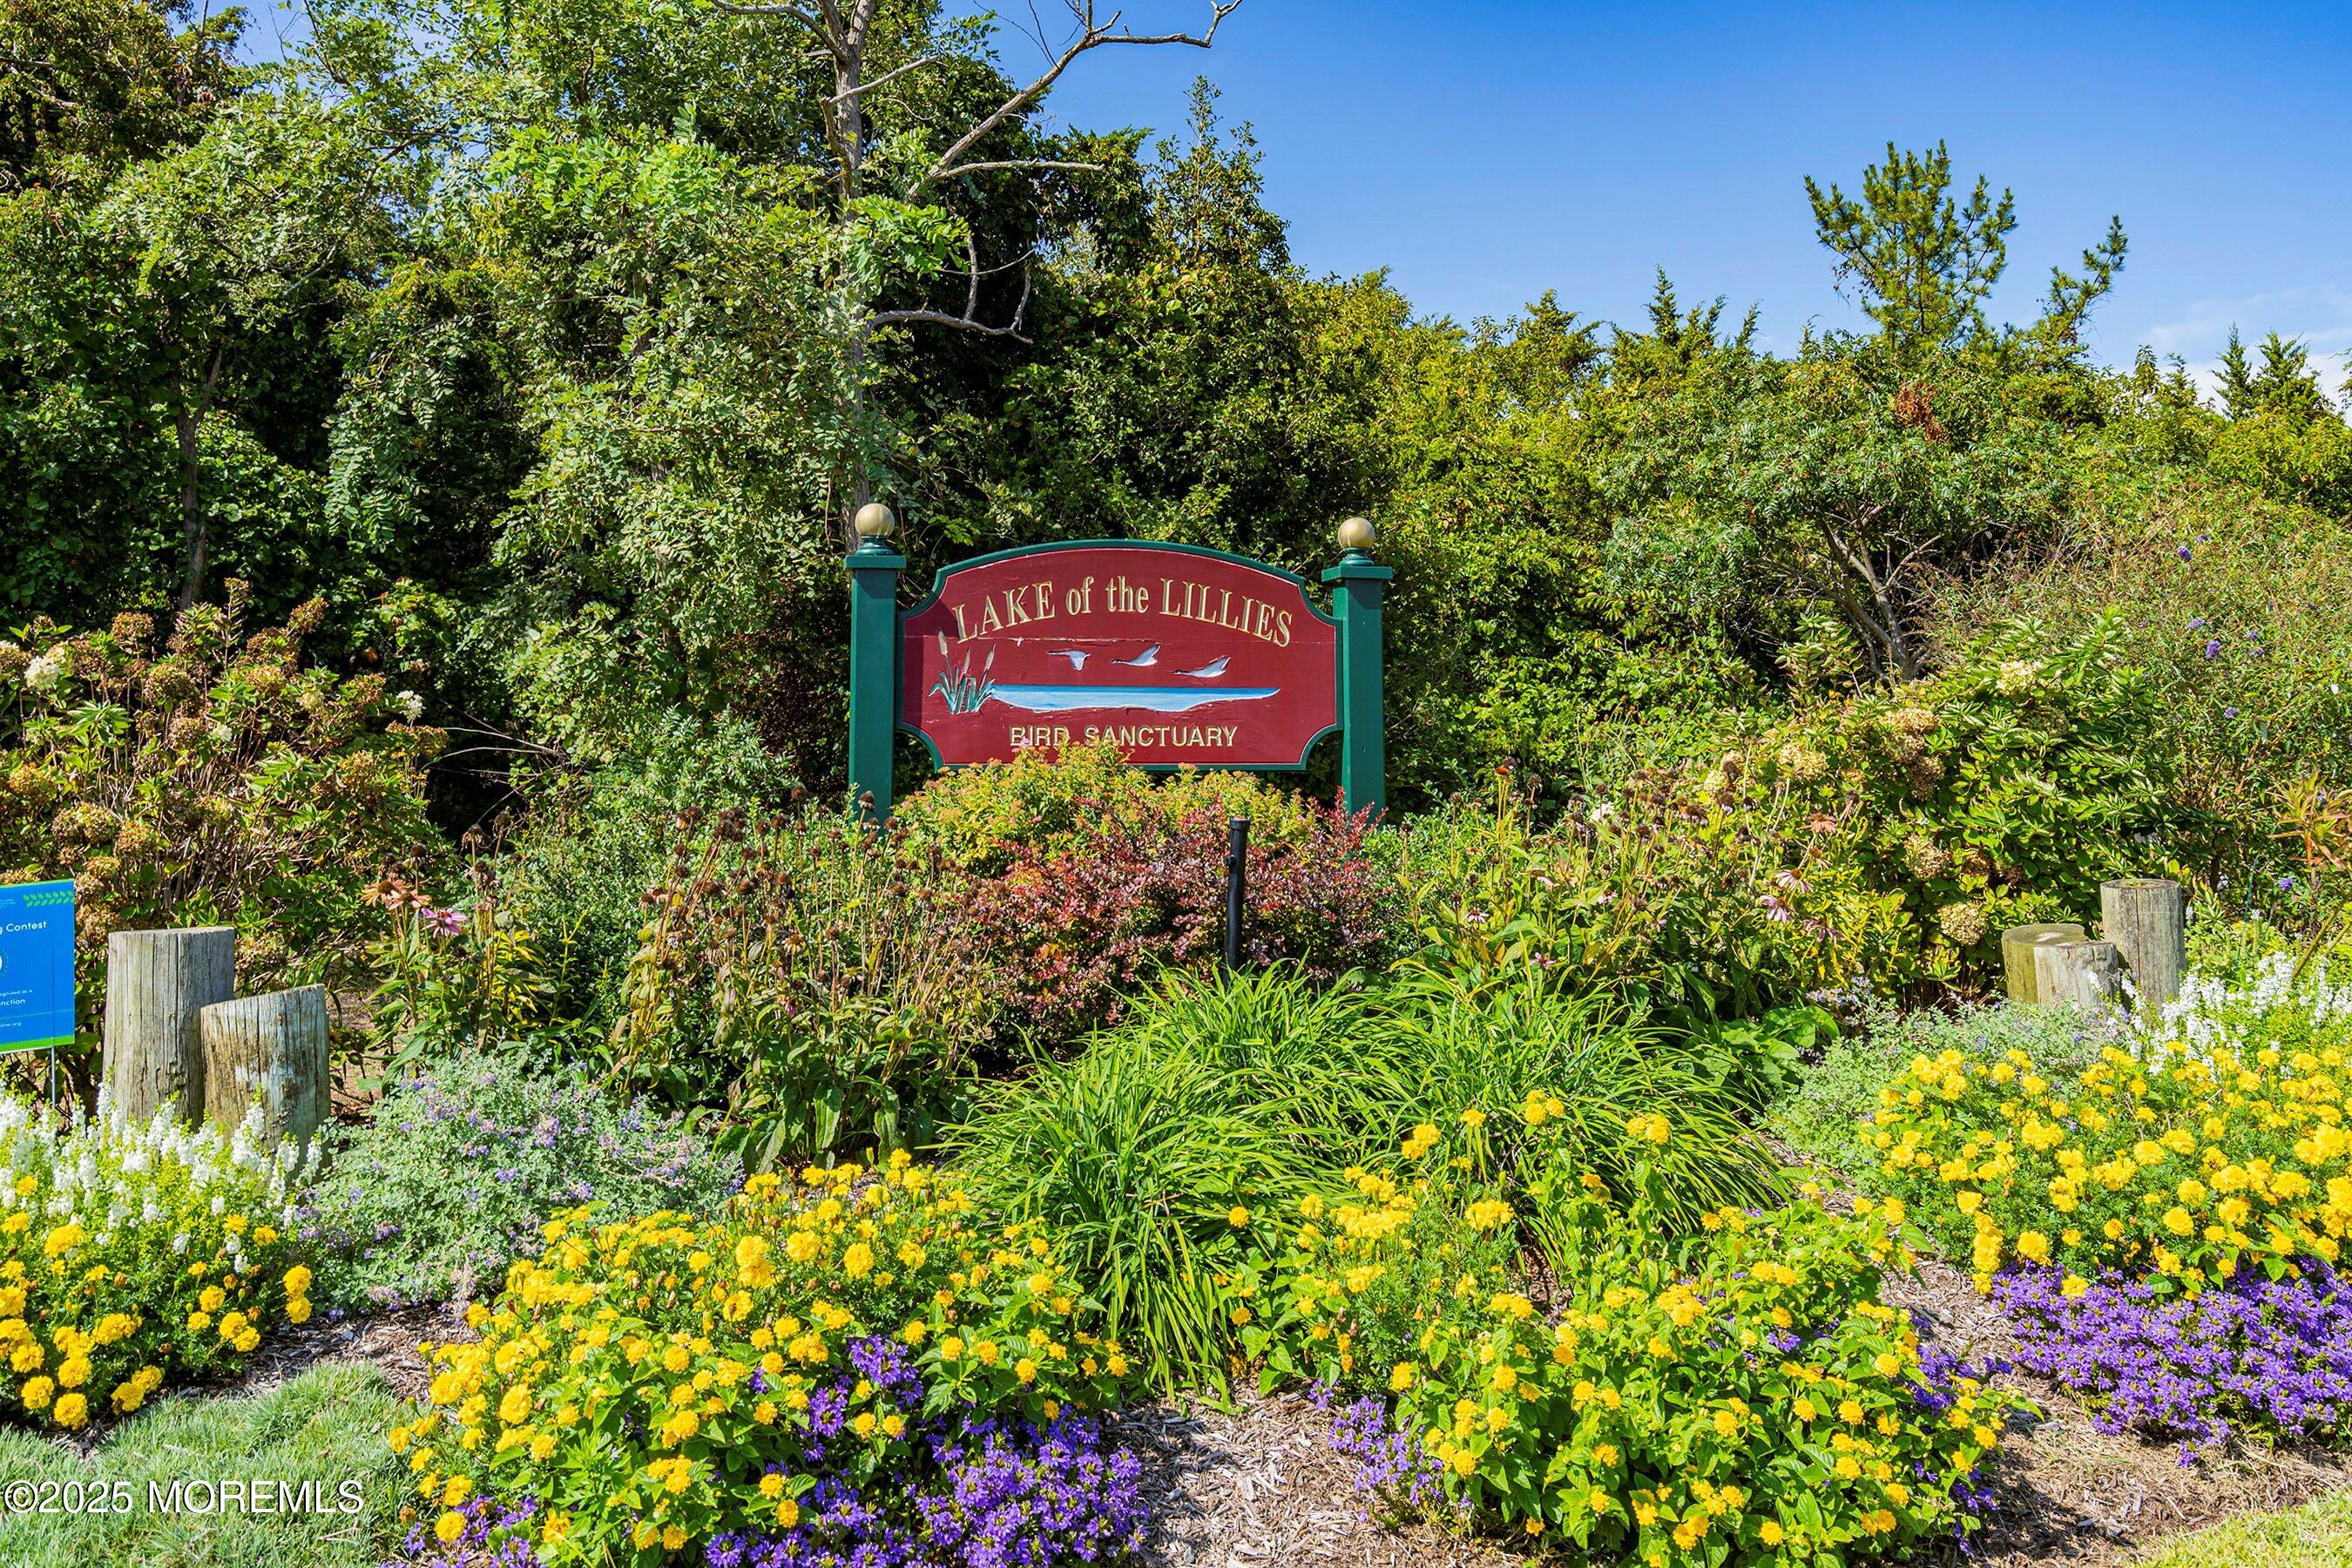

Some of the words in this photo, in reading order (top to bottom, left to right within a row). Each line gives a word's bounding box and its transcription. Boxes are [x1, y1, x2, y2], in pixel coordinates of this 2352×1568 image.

[952, 581, 1056, 645] LAKE
[1065, 576, 1094, 615] of
[1105, 576, 1149, 613] the
[1159, 578, 1293, 647] LILLIES
[1010, 726, 1070, 747] BIRD
[1084, 726, 1239, 747] SANCTUARY
[6, 921, 46, 932] Contest
